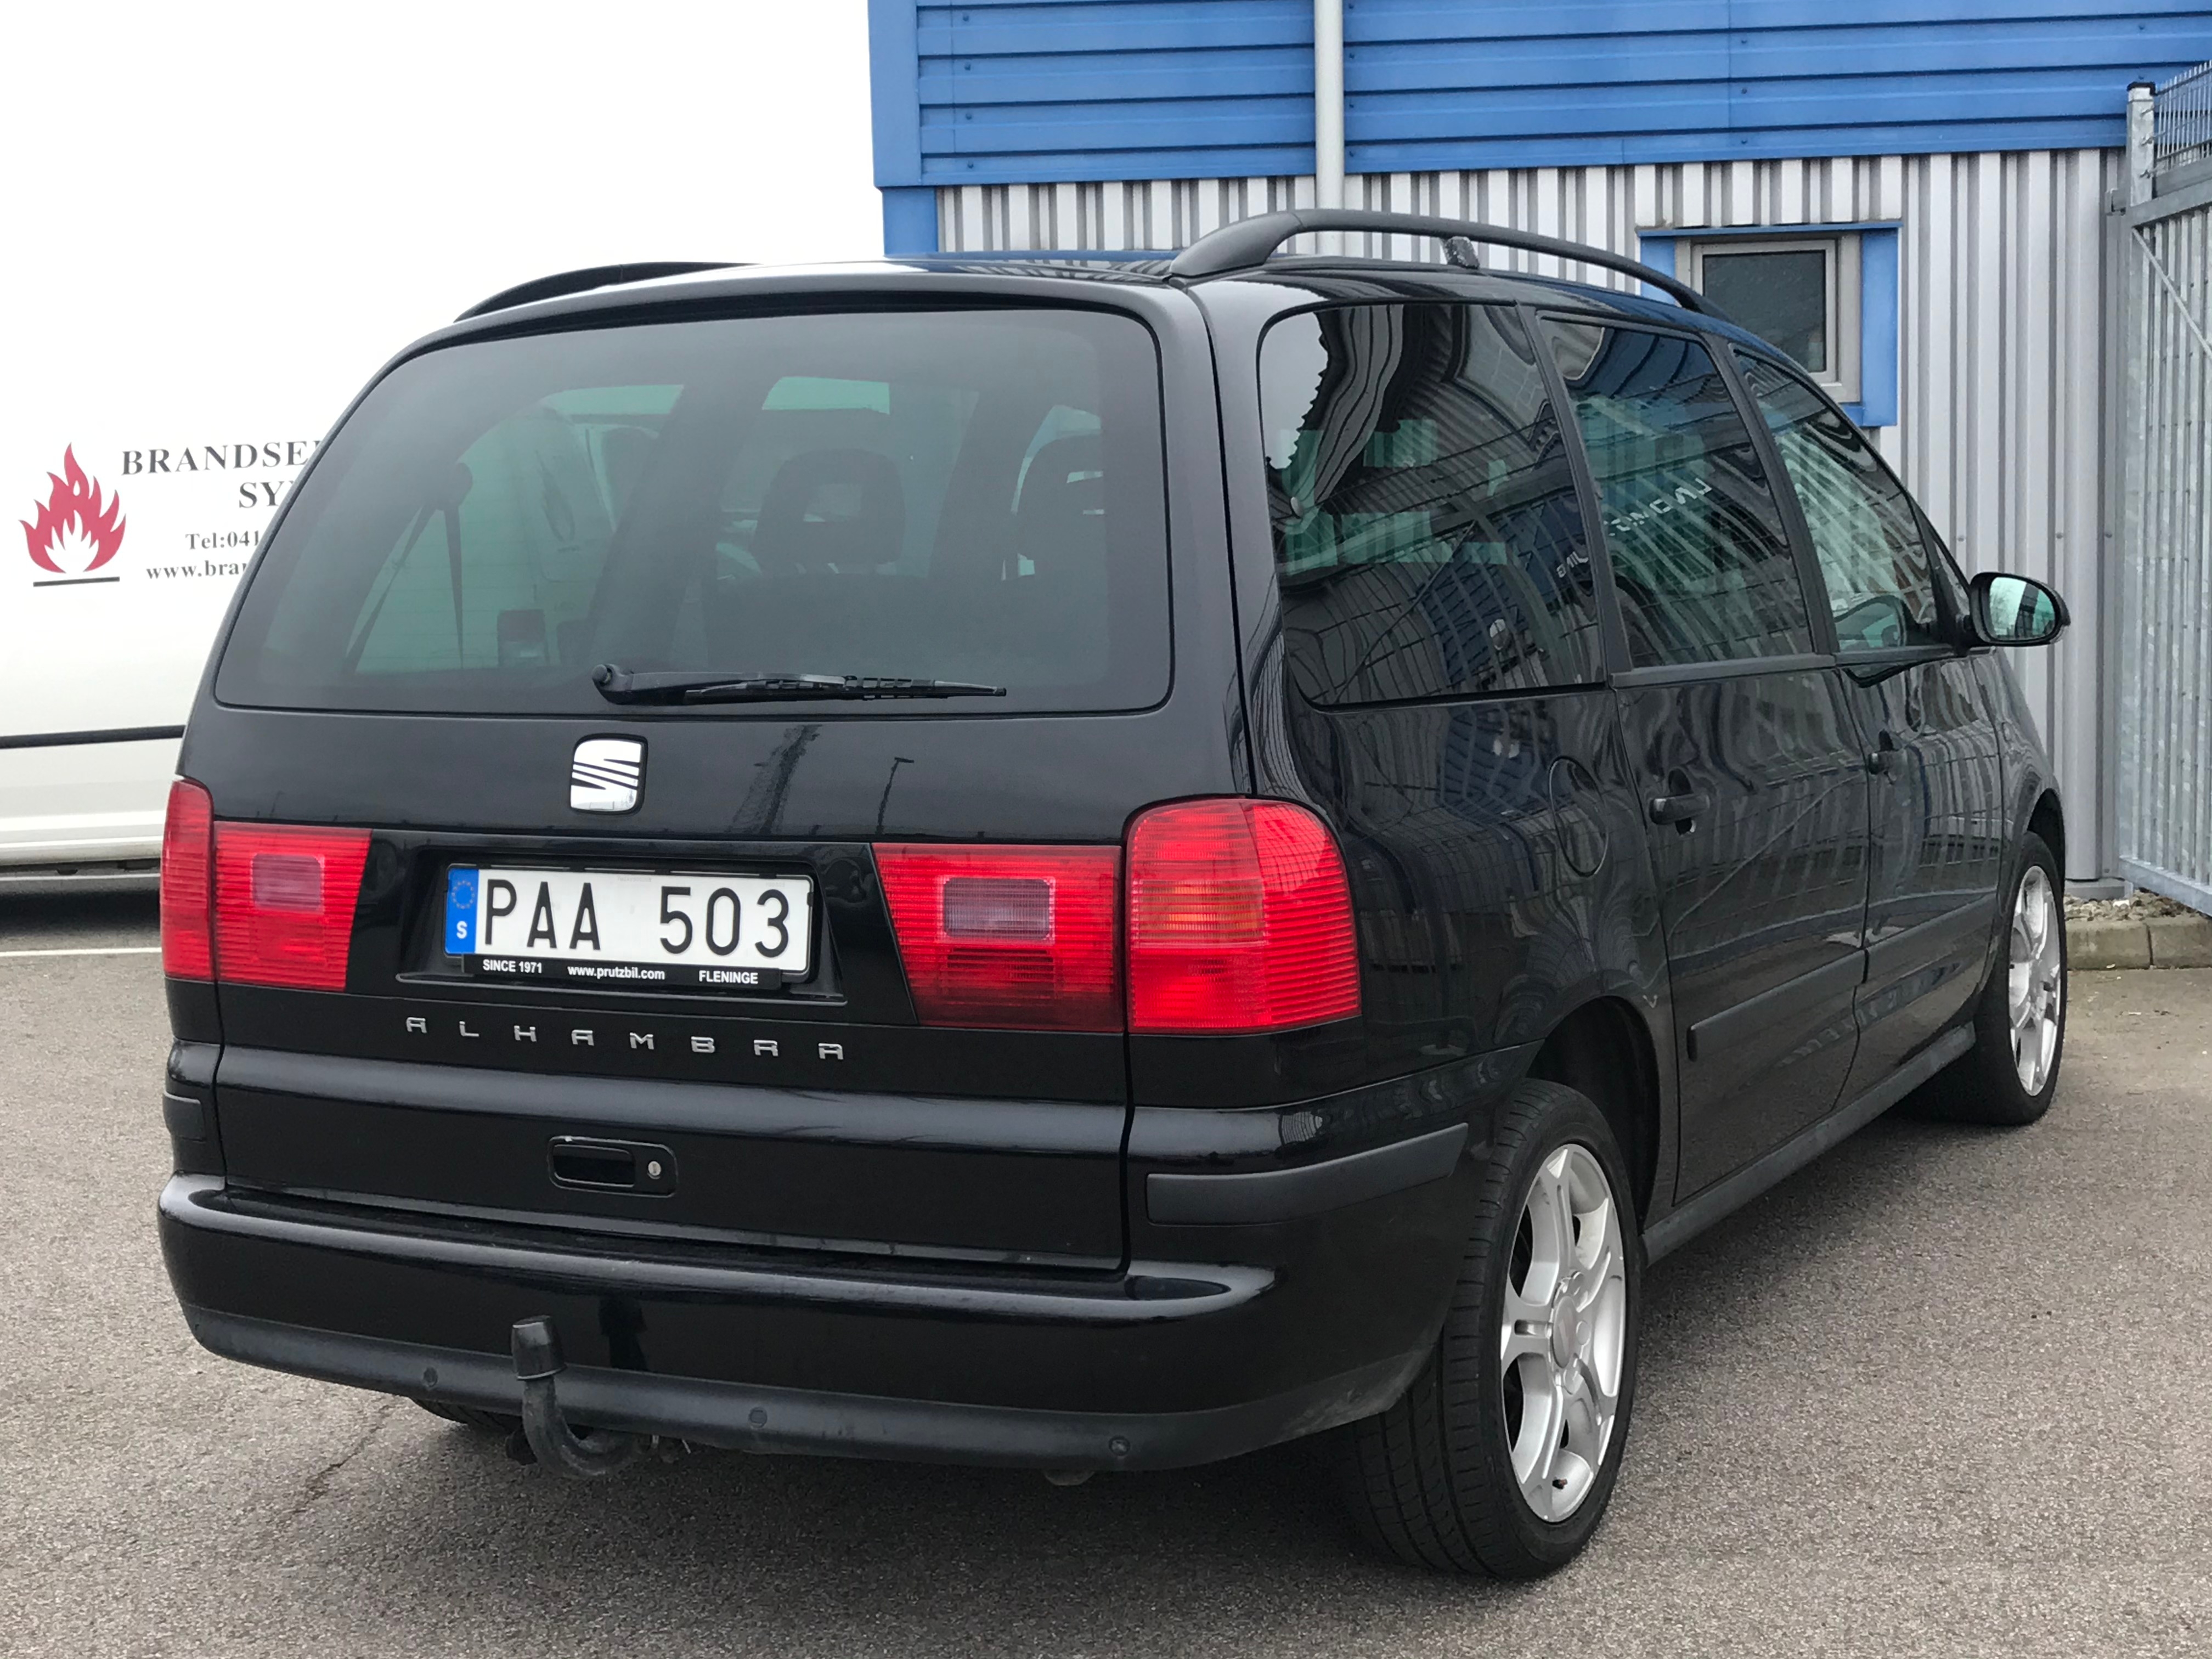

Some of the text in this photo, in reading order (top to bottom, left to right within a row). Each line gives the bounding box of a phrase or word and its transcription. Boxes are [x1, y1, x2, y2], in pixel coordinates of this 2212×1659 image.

[239, 479, 295, 509] SY
[456, 921, 467, 939] S
[485, 879, 789, 958] PAA 503
[483, 959, 758, 984] SINCE 1971 www.prutzbil.com FLENINGE
[405, 1016, 844, 1060] ALHAMBRA
